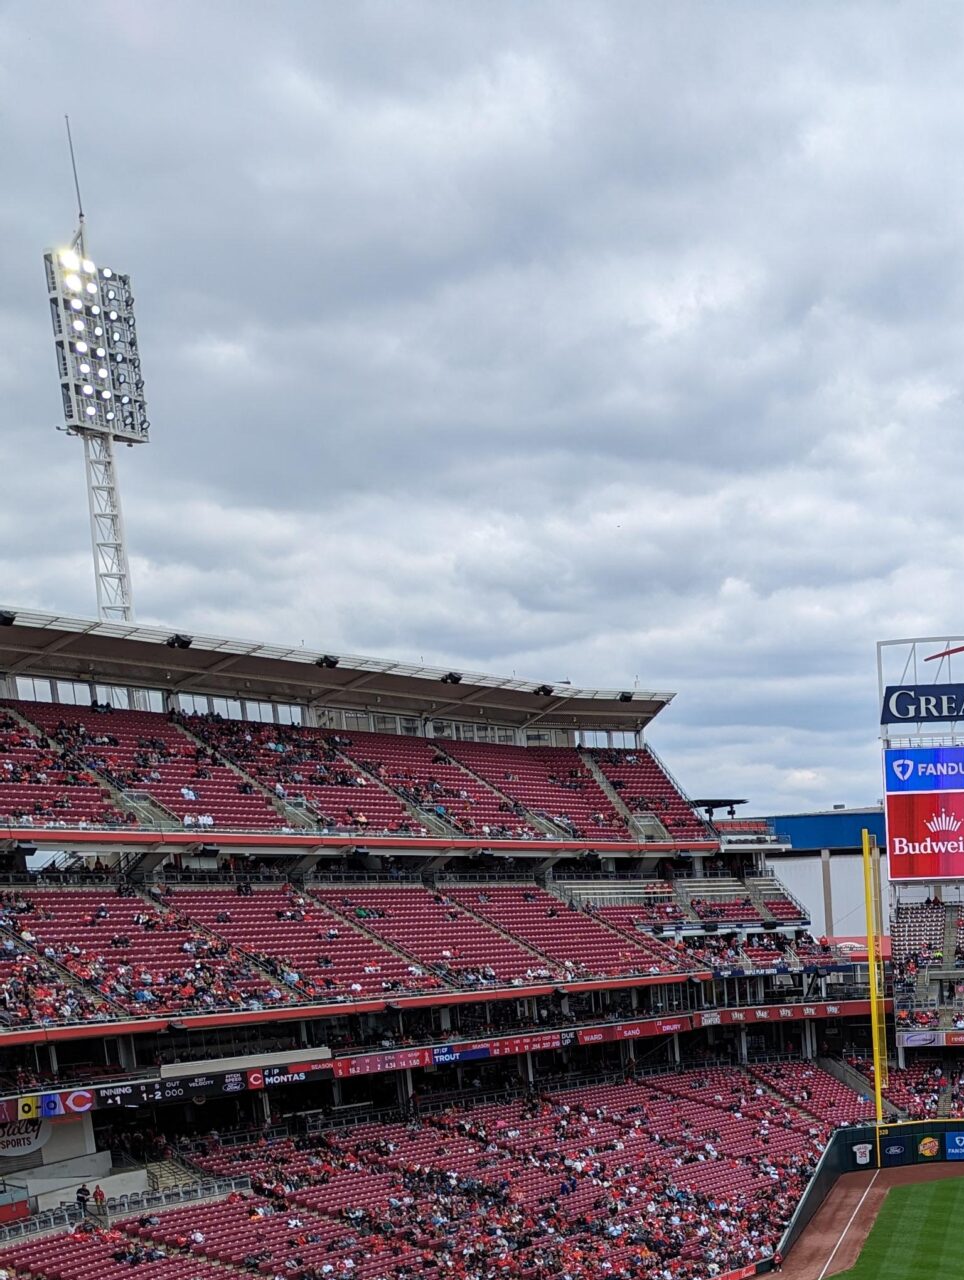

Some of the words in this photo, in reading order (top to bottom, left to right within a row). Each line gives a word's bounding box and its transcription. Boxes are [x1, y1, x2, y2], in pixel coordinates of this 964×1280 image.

[434, 1053, 460, 1062] TROUT
[265, 1072, 305, 1084] MONTAS
[100, 1087, 132, 1097] INNING
[1, 1137, 32, 1150] SPORTS
